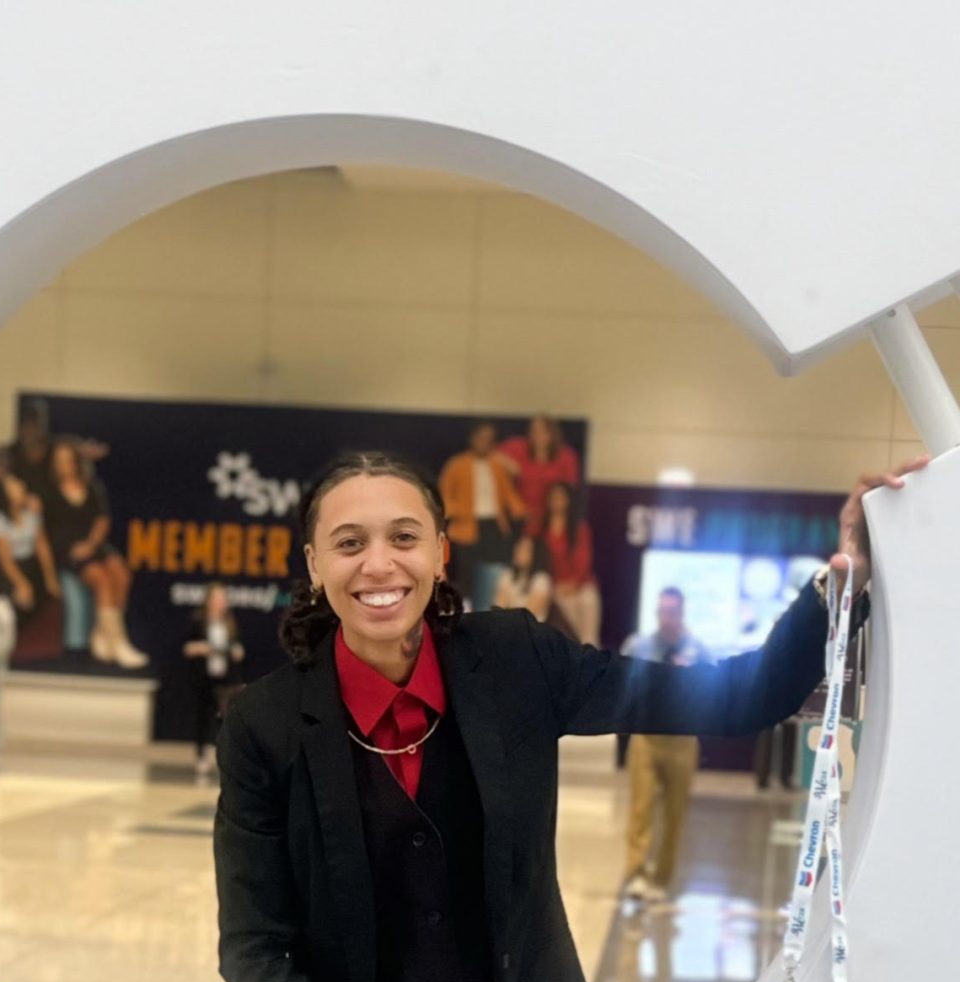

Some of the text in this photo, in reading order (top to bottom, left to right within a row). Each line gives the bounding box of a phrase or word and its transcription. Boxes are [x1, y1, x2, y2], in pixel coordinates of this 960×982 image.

[128, 518, 291, 577] MEMBER
[826, 683, 840, 731] Chevron
[803, 820, 820, 868] Chevron
[831, 849, 840, 896] Chevron
